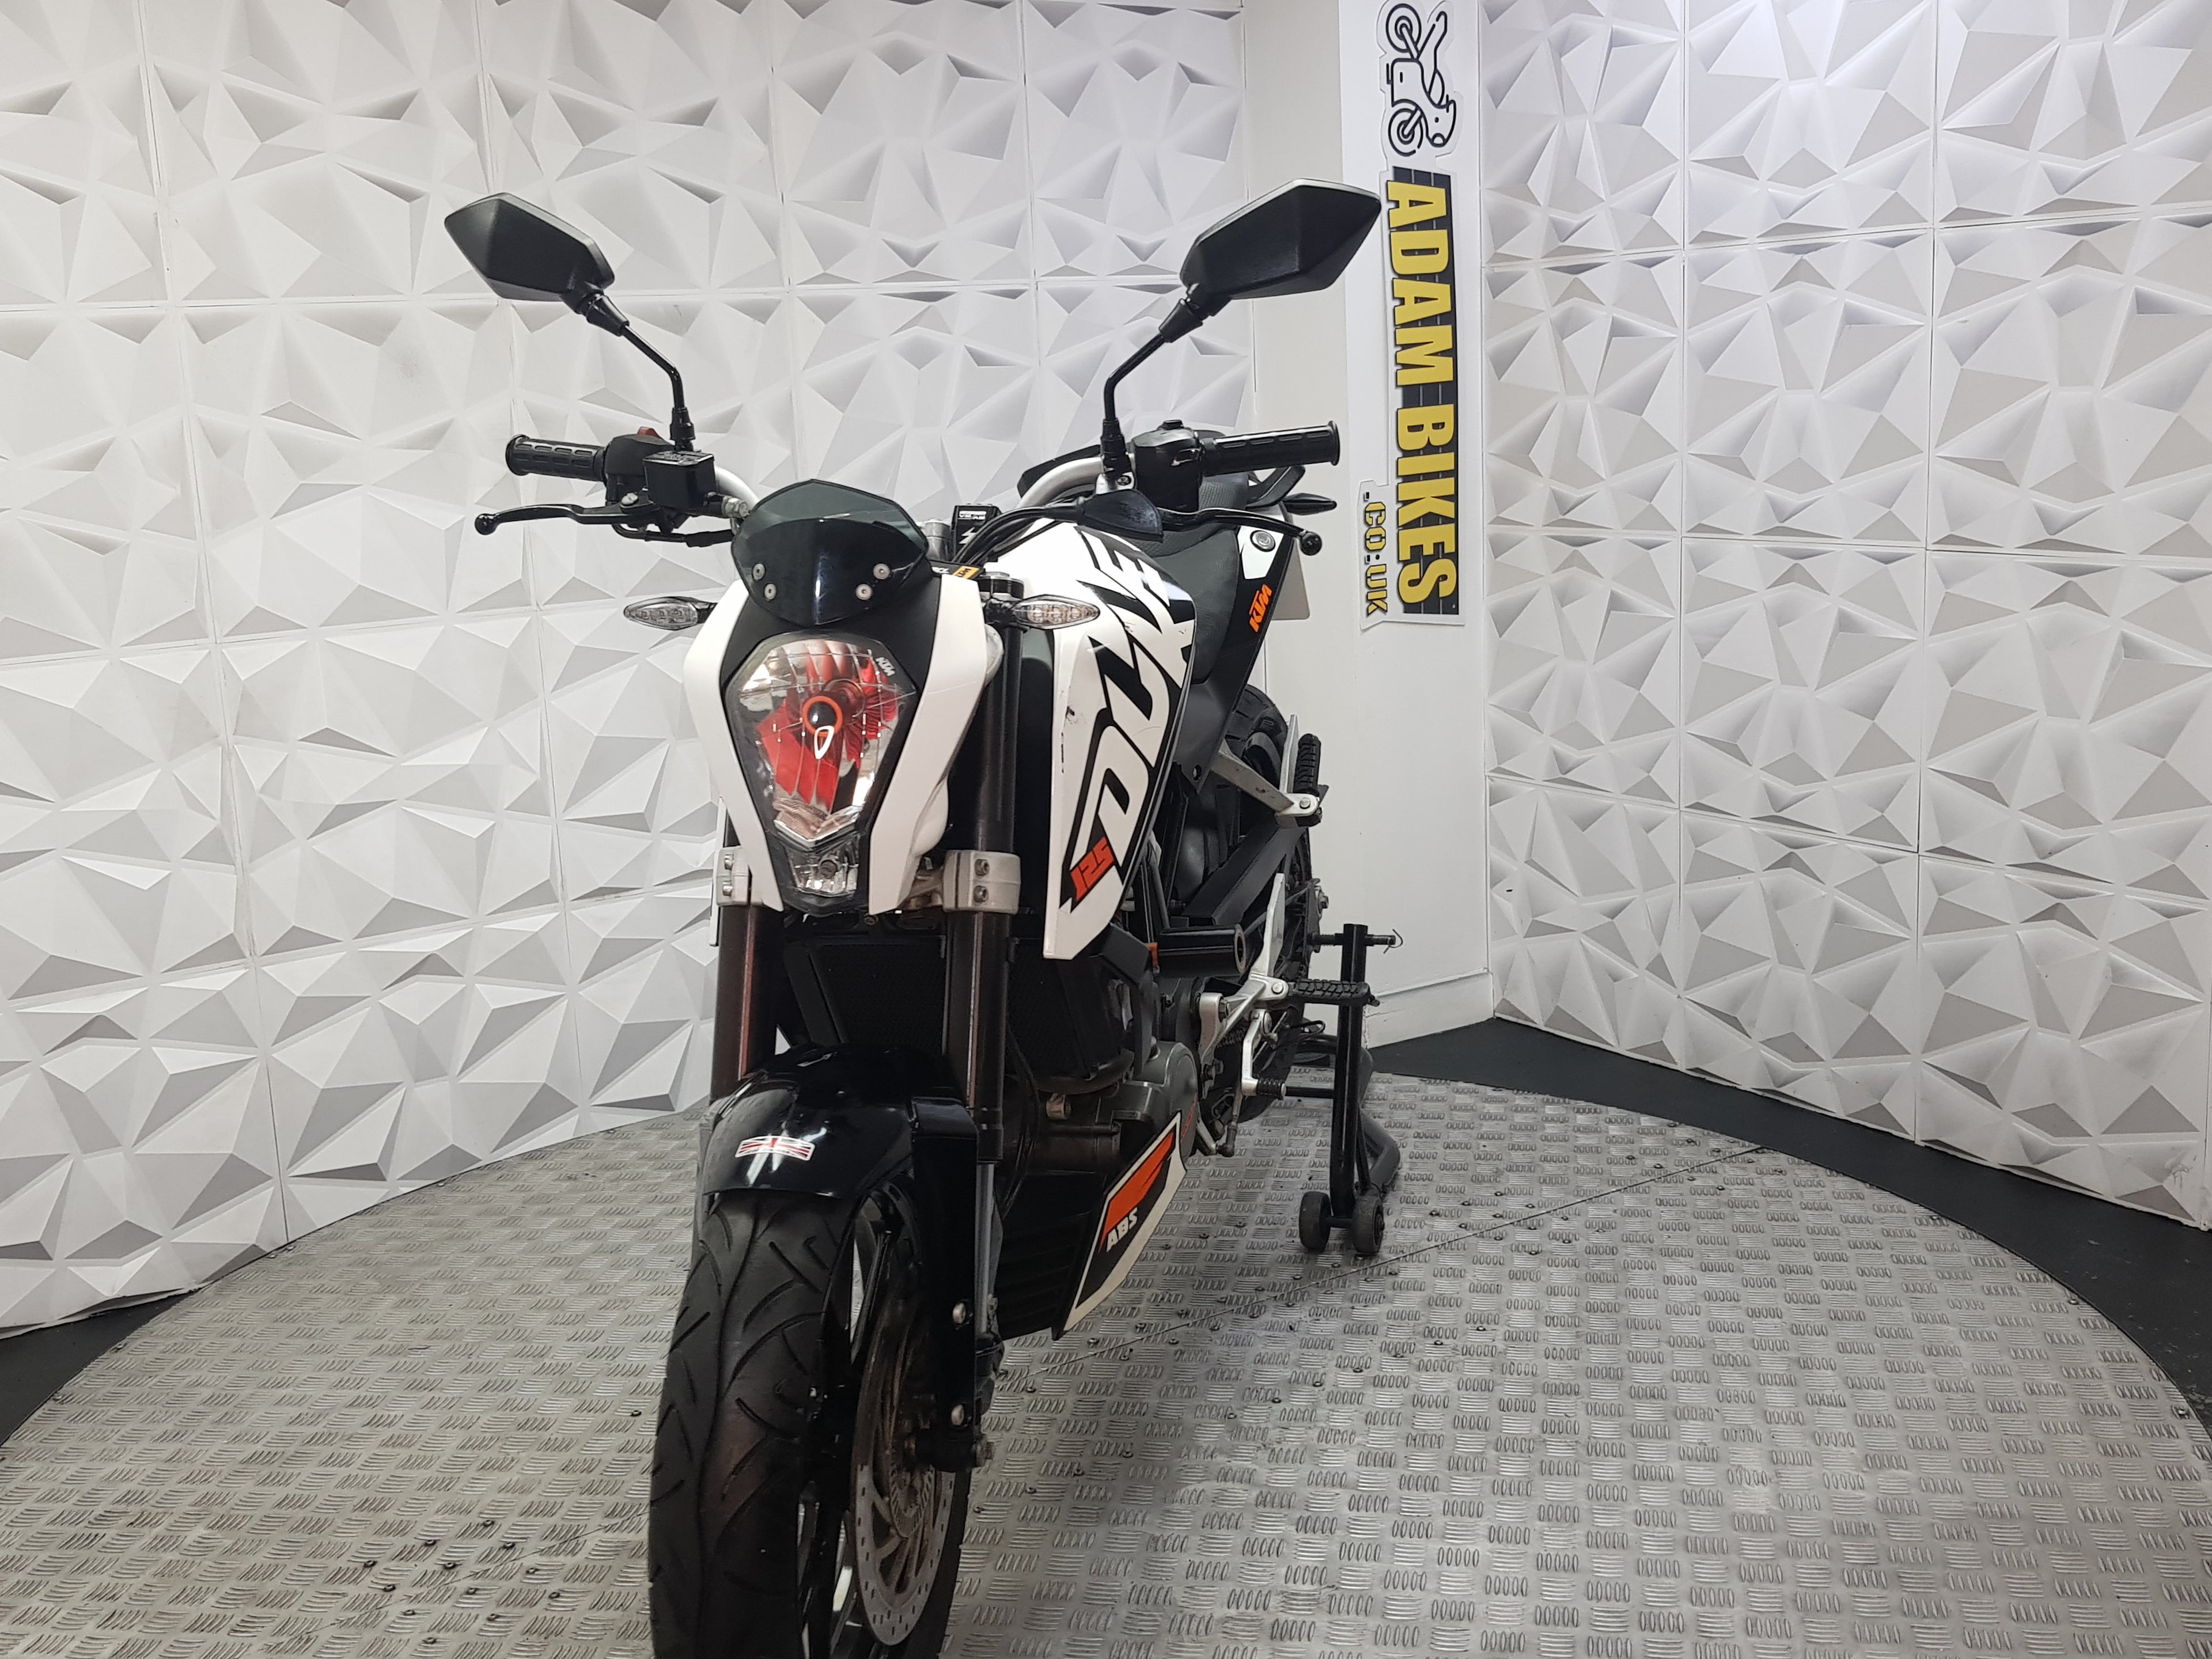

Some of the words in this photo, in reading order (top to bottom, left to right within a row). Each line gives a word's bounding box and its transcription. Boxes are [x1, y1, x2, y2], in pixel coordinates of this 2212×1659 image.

[1387, 180, 1454, 386] ADAM
[1397, 403, 1457, 603] BIKES
[1249, 584, 1272, 632] KTM
[875, 657, 895, 676] KTM
[1070, 529, 1195, 868] DUKE
[1070, 836, 1115, 902] 125
[1106, 1207, 1138, 1252] ABS
